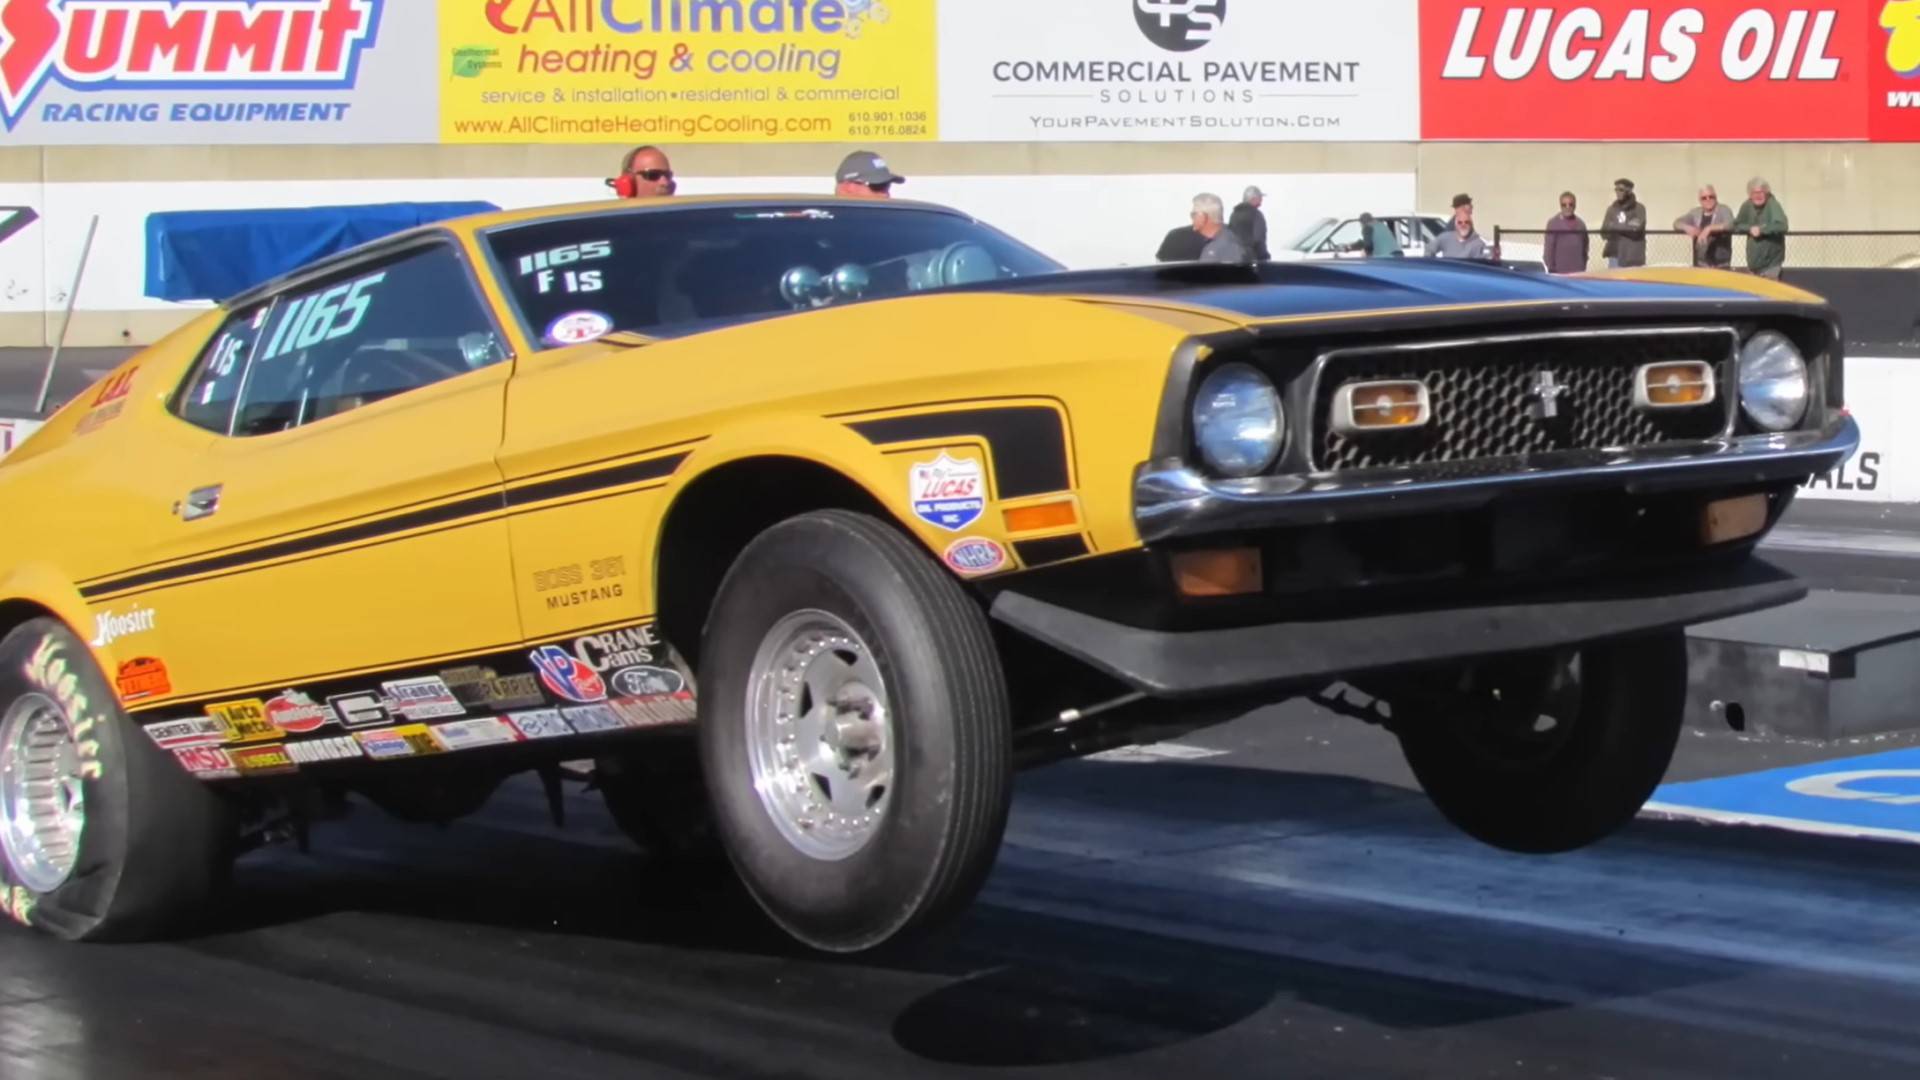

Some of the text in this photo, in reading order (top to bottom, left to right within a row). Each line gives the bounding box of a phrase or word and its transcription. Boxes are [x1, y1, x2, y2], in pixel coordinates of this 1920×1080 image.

[1441, 7, 1704, 82] LUCAS
[1720, 9, 1841, 81] OIL
[517, 43, 841, 80] heating & cooling
[992, 61, 1360, 82] COMMERCIAL PAVEMENT
[481, 89, 545, 103] service
[553, 88, 565, 102] &
[776, 86, 788, 101] &
[794, 86, 900, 101] commercial
[1100, 90, 1254, 103] SOLUTIONS
[42, 103, 350, 122] RACING EQUIPMENT
[849, 111, 927, 122] 610.901.1036
[454, 114, 832, 137] www.AllClimateHeatingCooling.com
[849, 125, 927, 136] 610.716.0824
[519, 240, 611, 275] 1165
[261, 272, 386, 361] 1165
[922, 478, 977, 499] LUCAS
[532, 563, 583, 592] BOSS
[546, 584, 623, 609] MUSTANG
[575, 624, 661, 672] CRANE
